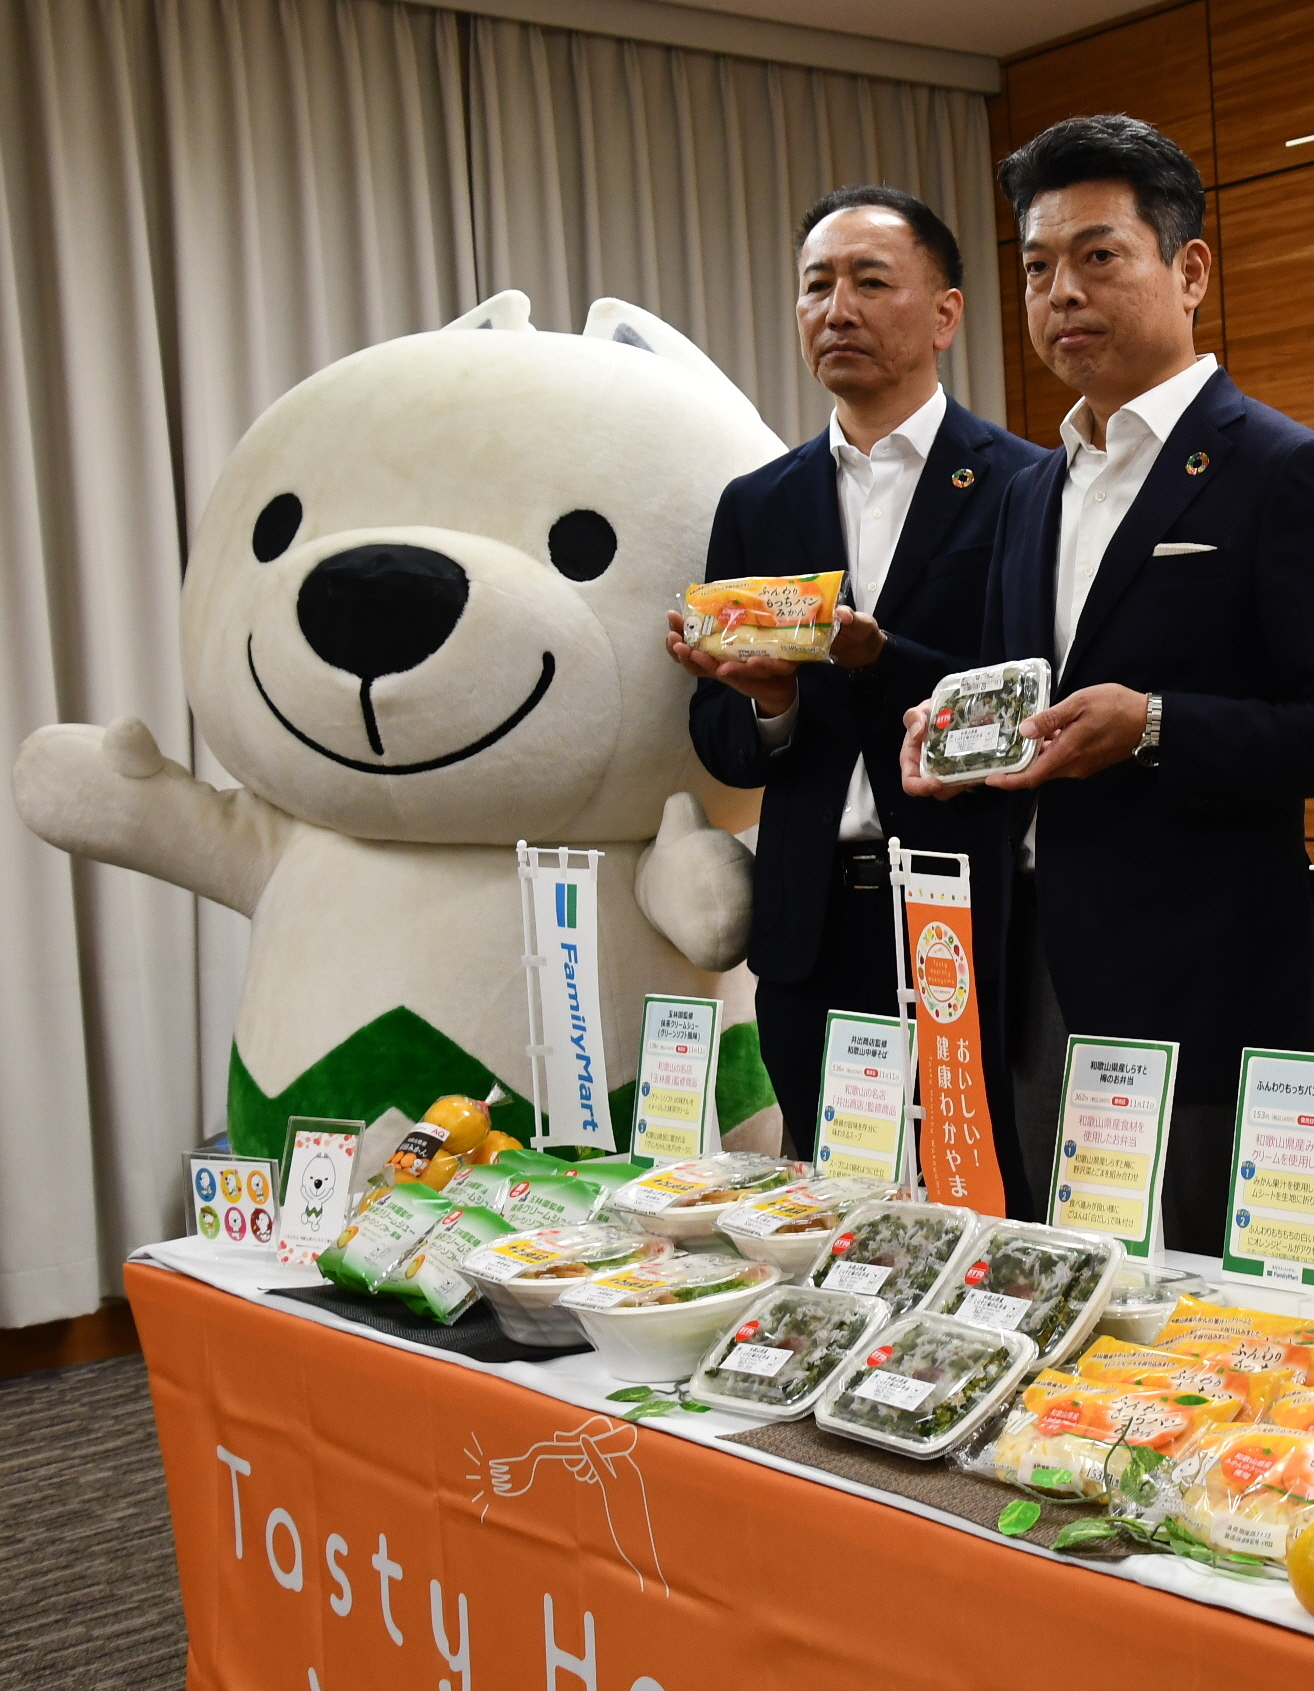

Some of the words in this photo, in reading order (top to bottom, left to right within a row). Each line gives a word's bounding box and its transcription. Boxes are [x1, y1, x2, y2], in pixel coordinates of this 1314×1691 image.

[758, 586, 799, 597] ふんわり
[766, 596, 820, 609] もっちパン
[776, 608, 807, 617] みかん
[560, 942, 599, 1132] FamilyMart
[1090, 1060, 1148, 1075] 和歌山県産しらすと
[1099, 1074, 1134, 1086] 梅のお弁当
[956, 1038, 981, 1168] おいしい!
[936, 1035, 968, 1198] 健康わかやま
[1079, 1115, 1145, 1133] 和歌山県産食材を
[1083, 1130, 1137, 1147] 使用したお弁当
[1273, 1272, 1298, 1281] FamilyMart
[1231, 1343, 1282, 1363] ふんわり
[216, 1444, 473, 1691] Tasty
